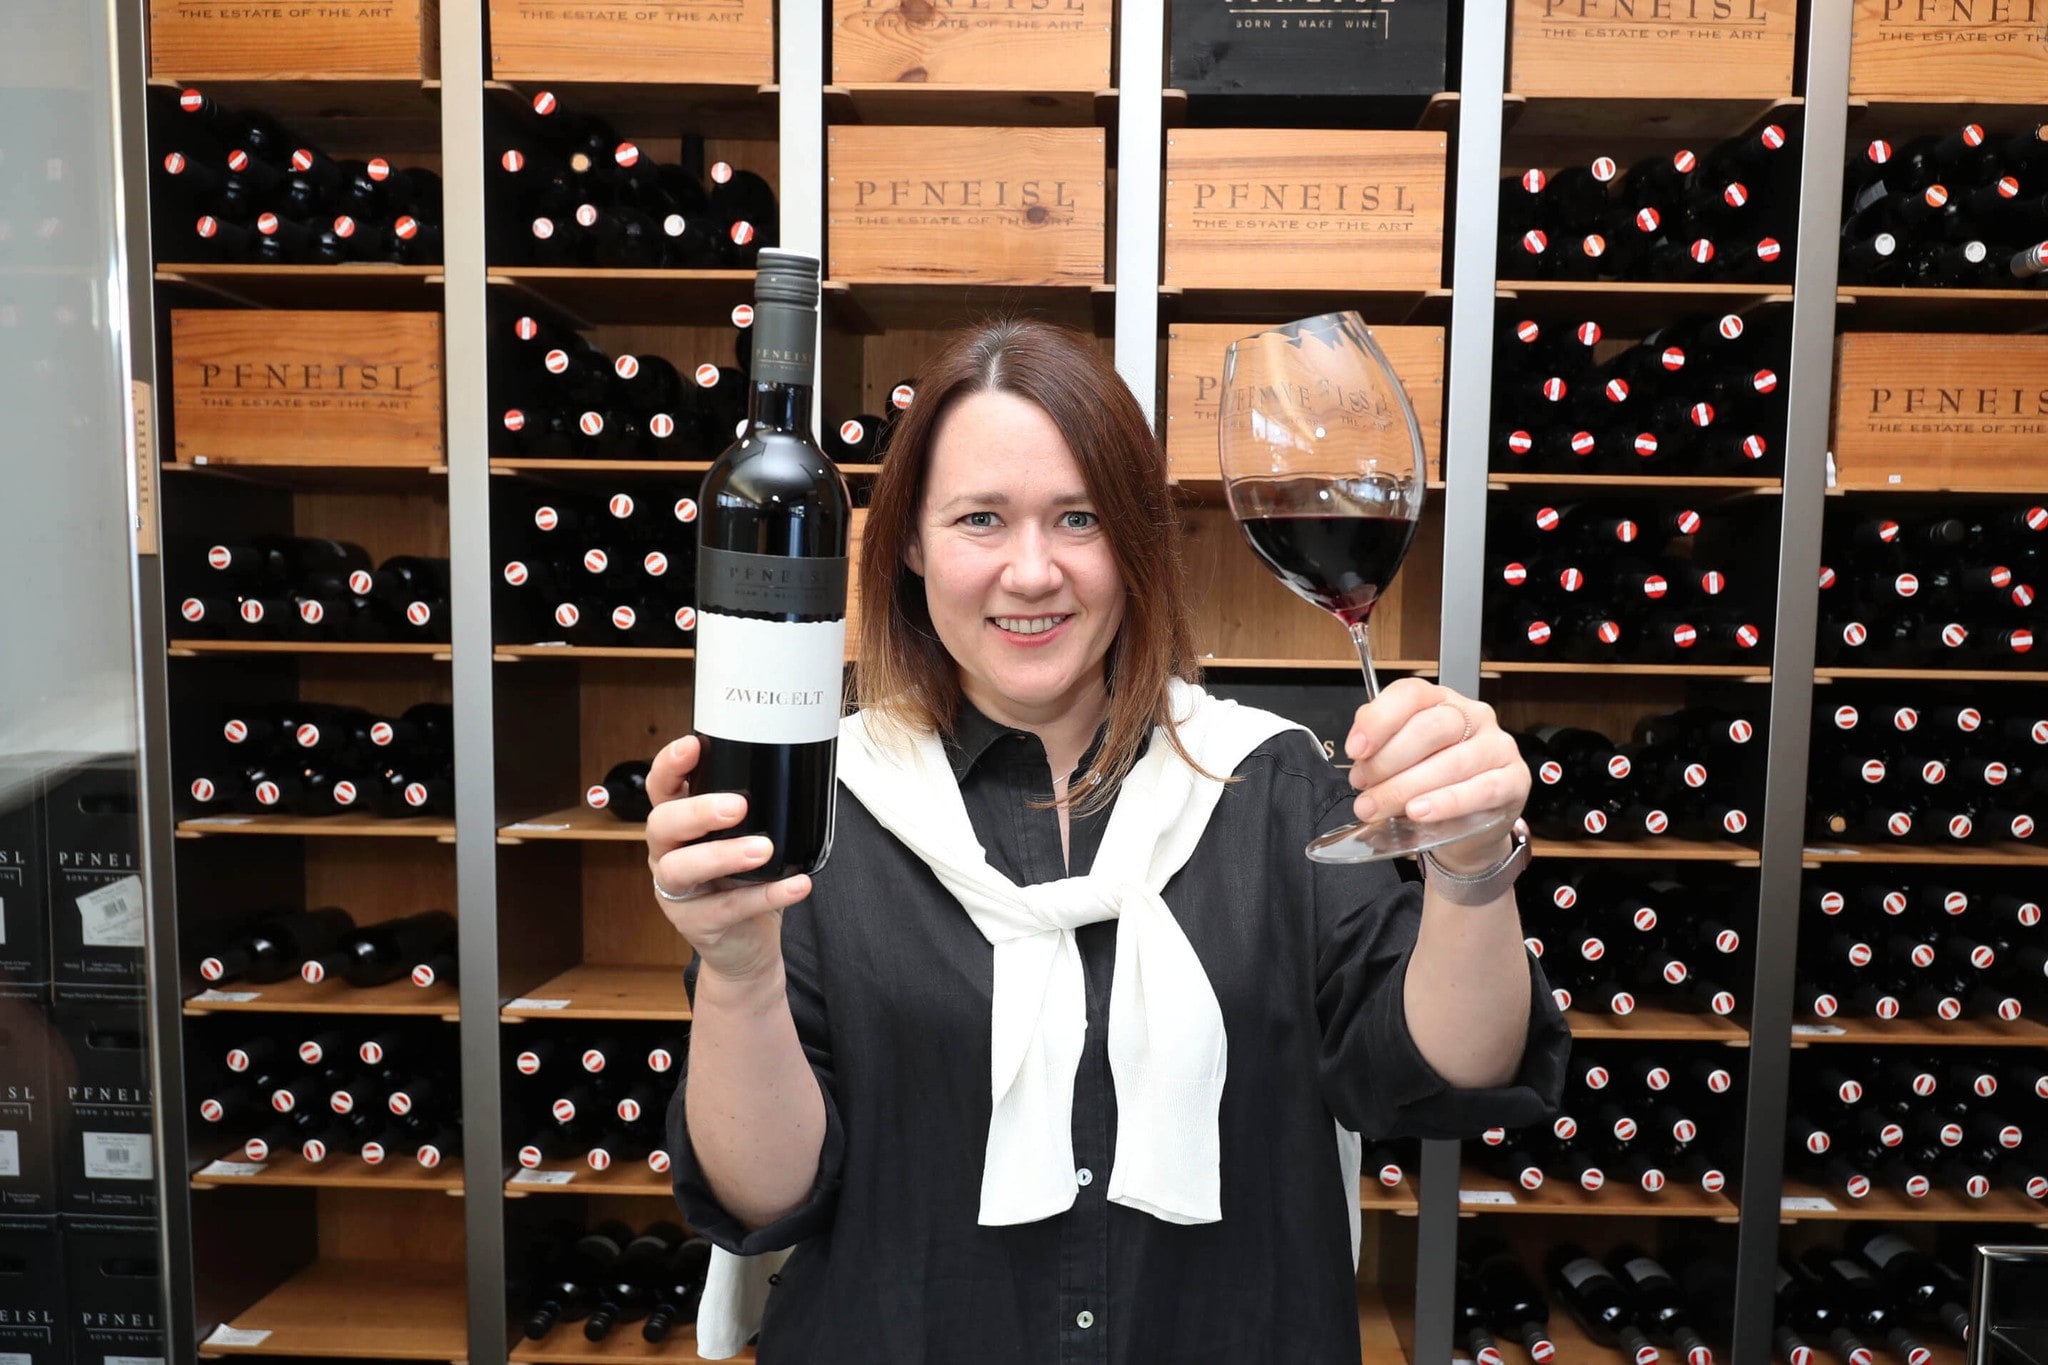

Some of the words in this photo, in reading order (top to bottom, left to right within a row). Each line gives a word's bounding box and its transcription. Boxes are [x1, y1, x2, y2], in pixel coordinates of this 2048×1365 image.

[179, 9, 212, 18] THE
[220, 9, 282, 18] ESTATE
[289, 9, 310, 18] OF
[319, 8, 350, 18] THE
[358, 8, 394, 18] ART
[521, 10, 558, 20] THE
[563, 11, 628, 21] ESTATE
[635, 11, 659, 21] OF
[667, 12, 700, 22] THE
[706, 12, 744, 23] ART
[862, 18, 896, 28] THE
[976, 20, 994, 29] OF
[1007, 20, 1041, 30] THE
[1046, 20, 1084, 30] ART
[1236, 19, 1271, 29] BORN
[1281, 20, 1288, 29] 2
[1298, 20, 1333, 29] MAKE
[1345, 20, 1378, 29] WINE
[1541, 28, 1579, 38] THE
[1584, 29, 1649, 39] ESTATE
[1656, 29, 1678, 39] OF
[1687, 29, 1721, 40] THE
[1729, 30, 1765, 40] ART
[1879, 31, 1914, 41] THE
[1922, 32, 1988, 42] ESTATE
[1994, 33, 2018, 42] OF
[854, 179, 1075, 208] PFNEISL
[1193, 182, 1415, 214] PFNEISL
[855, 216, 889, 226] THE
[897, 216, 960, 226] ESTATE
[967, 216, 990, 226] OF
[1192, 218, 1228, 229] THE
[1235, 219, 1299, 230] ESTATE
[1306, 220, 1330, 230] OF
[1336, 221, 1371, 231] THE
[1376, 222, 1413, 232] ART
[200, 363, 412, 392] PFNEISL
[202, 398, 234, 407] THE
[241, 399, 301, 408] ESTATE
[309, 400, 329, 408] OF
[340, 400, 367, 409] THE
[377, 400, 412, 410] ART
[1868, 423, 1902, 433] THE
[1910, 424, 1974, 434] ESTATE
[1981, 424, 2005, 434] OF
[2010, 425, 2047, 434] THE
[725, 687, 824, 706] ZWEIGELT
